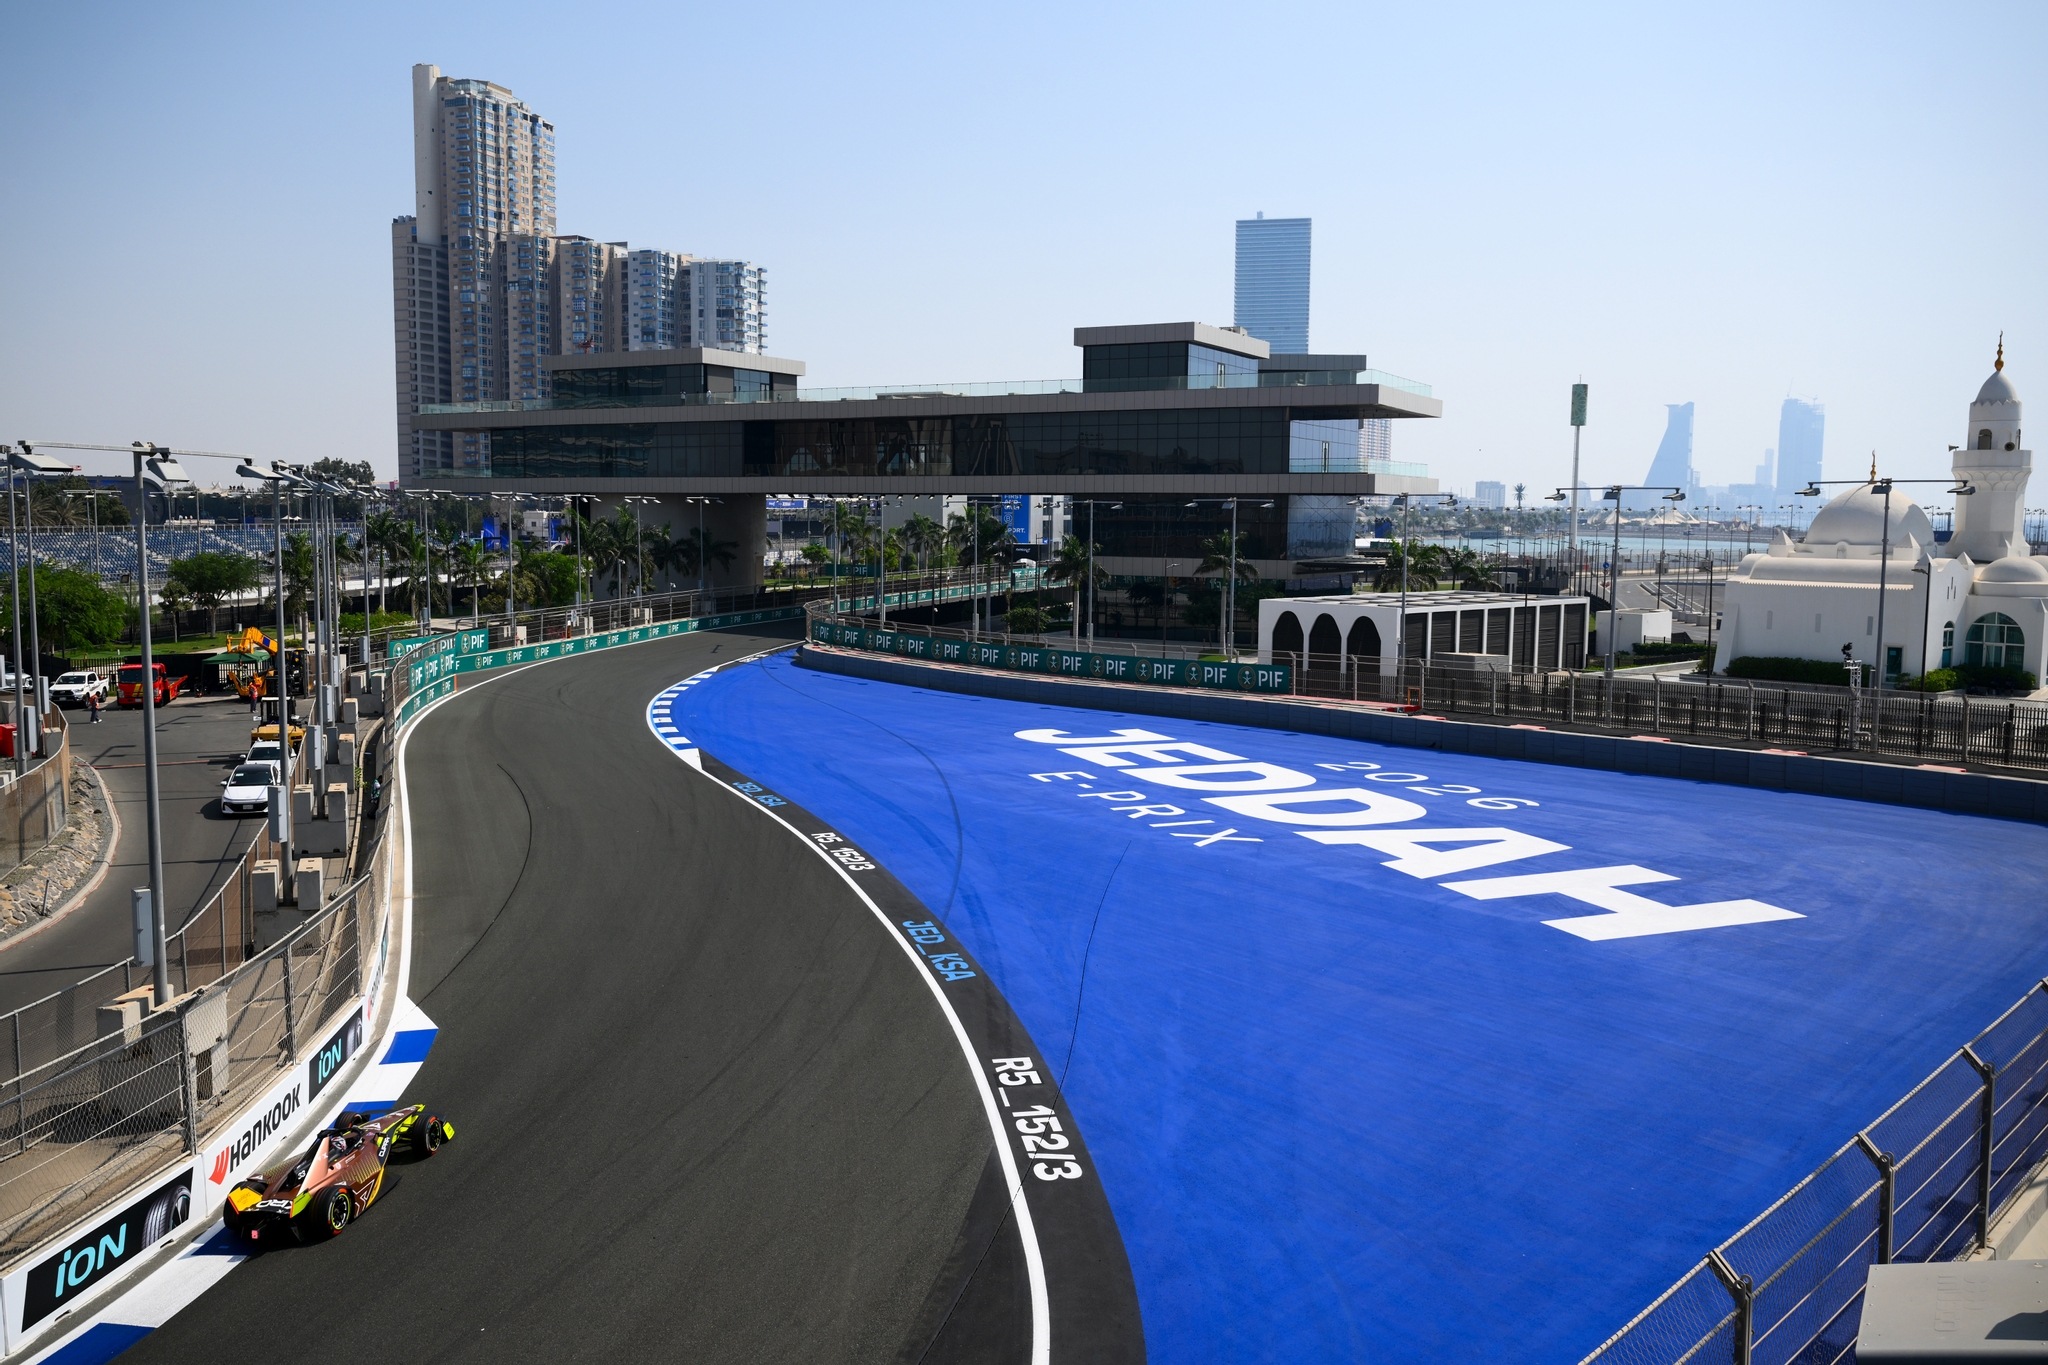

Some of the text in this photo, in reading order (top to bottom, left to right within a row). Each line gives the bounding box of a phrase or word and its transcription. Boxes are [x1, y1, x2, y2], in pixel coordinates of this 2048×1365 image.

[429, 660, 438, 677] PIF
[446, 654, 454, 671] PIF
[471, 634, 485, 649] PIF
[482, 656, 493, 666] PIF
[513, 651, 523, 661] PIF
[540, 647, 550, 656] PIF
[566, 643, 574, 652] PIF
[589, 638, 598, 648] PIF
[820, 626, 1283, 687] PIF PIF PIF PIF PIF PIF PIF PIF PIF PIF PIF PIF
[1315, 760, 1539, 811] 2026
[1029, 772, 1263, 849] E-PRIX
[1014, 729, 1807, 941] JEDDAH
[318, 1038, 341, 1084] iON
[378, 1136, 390, 1157] CUPRA
[55, 1223, 127, 1298] iON
